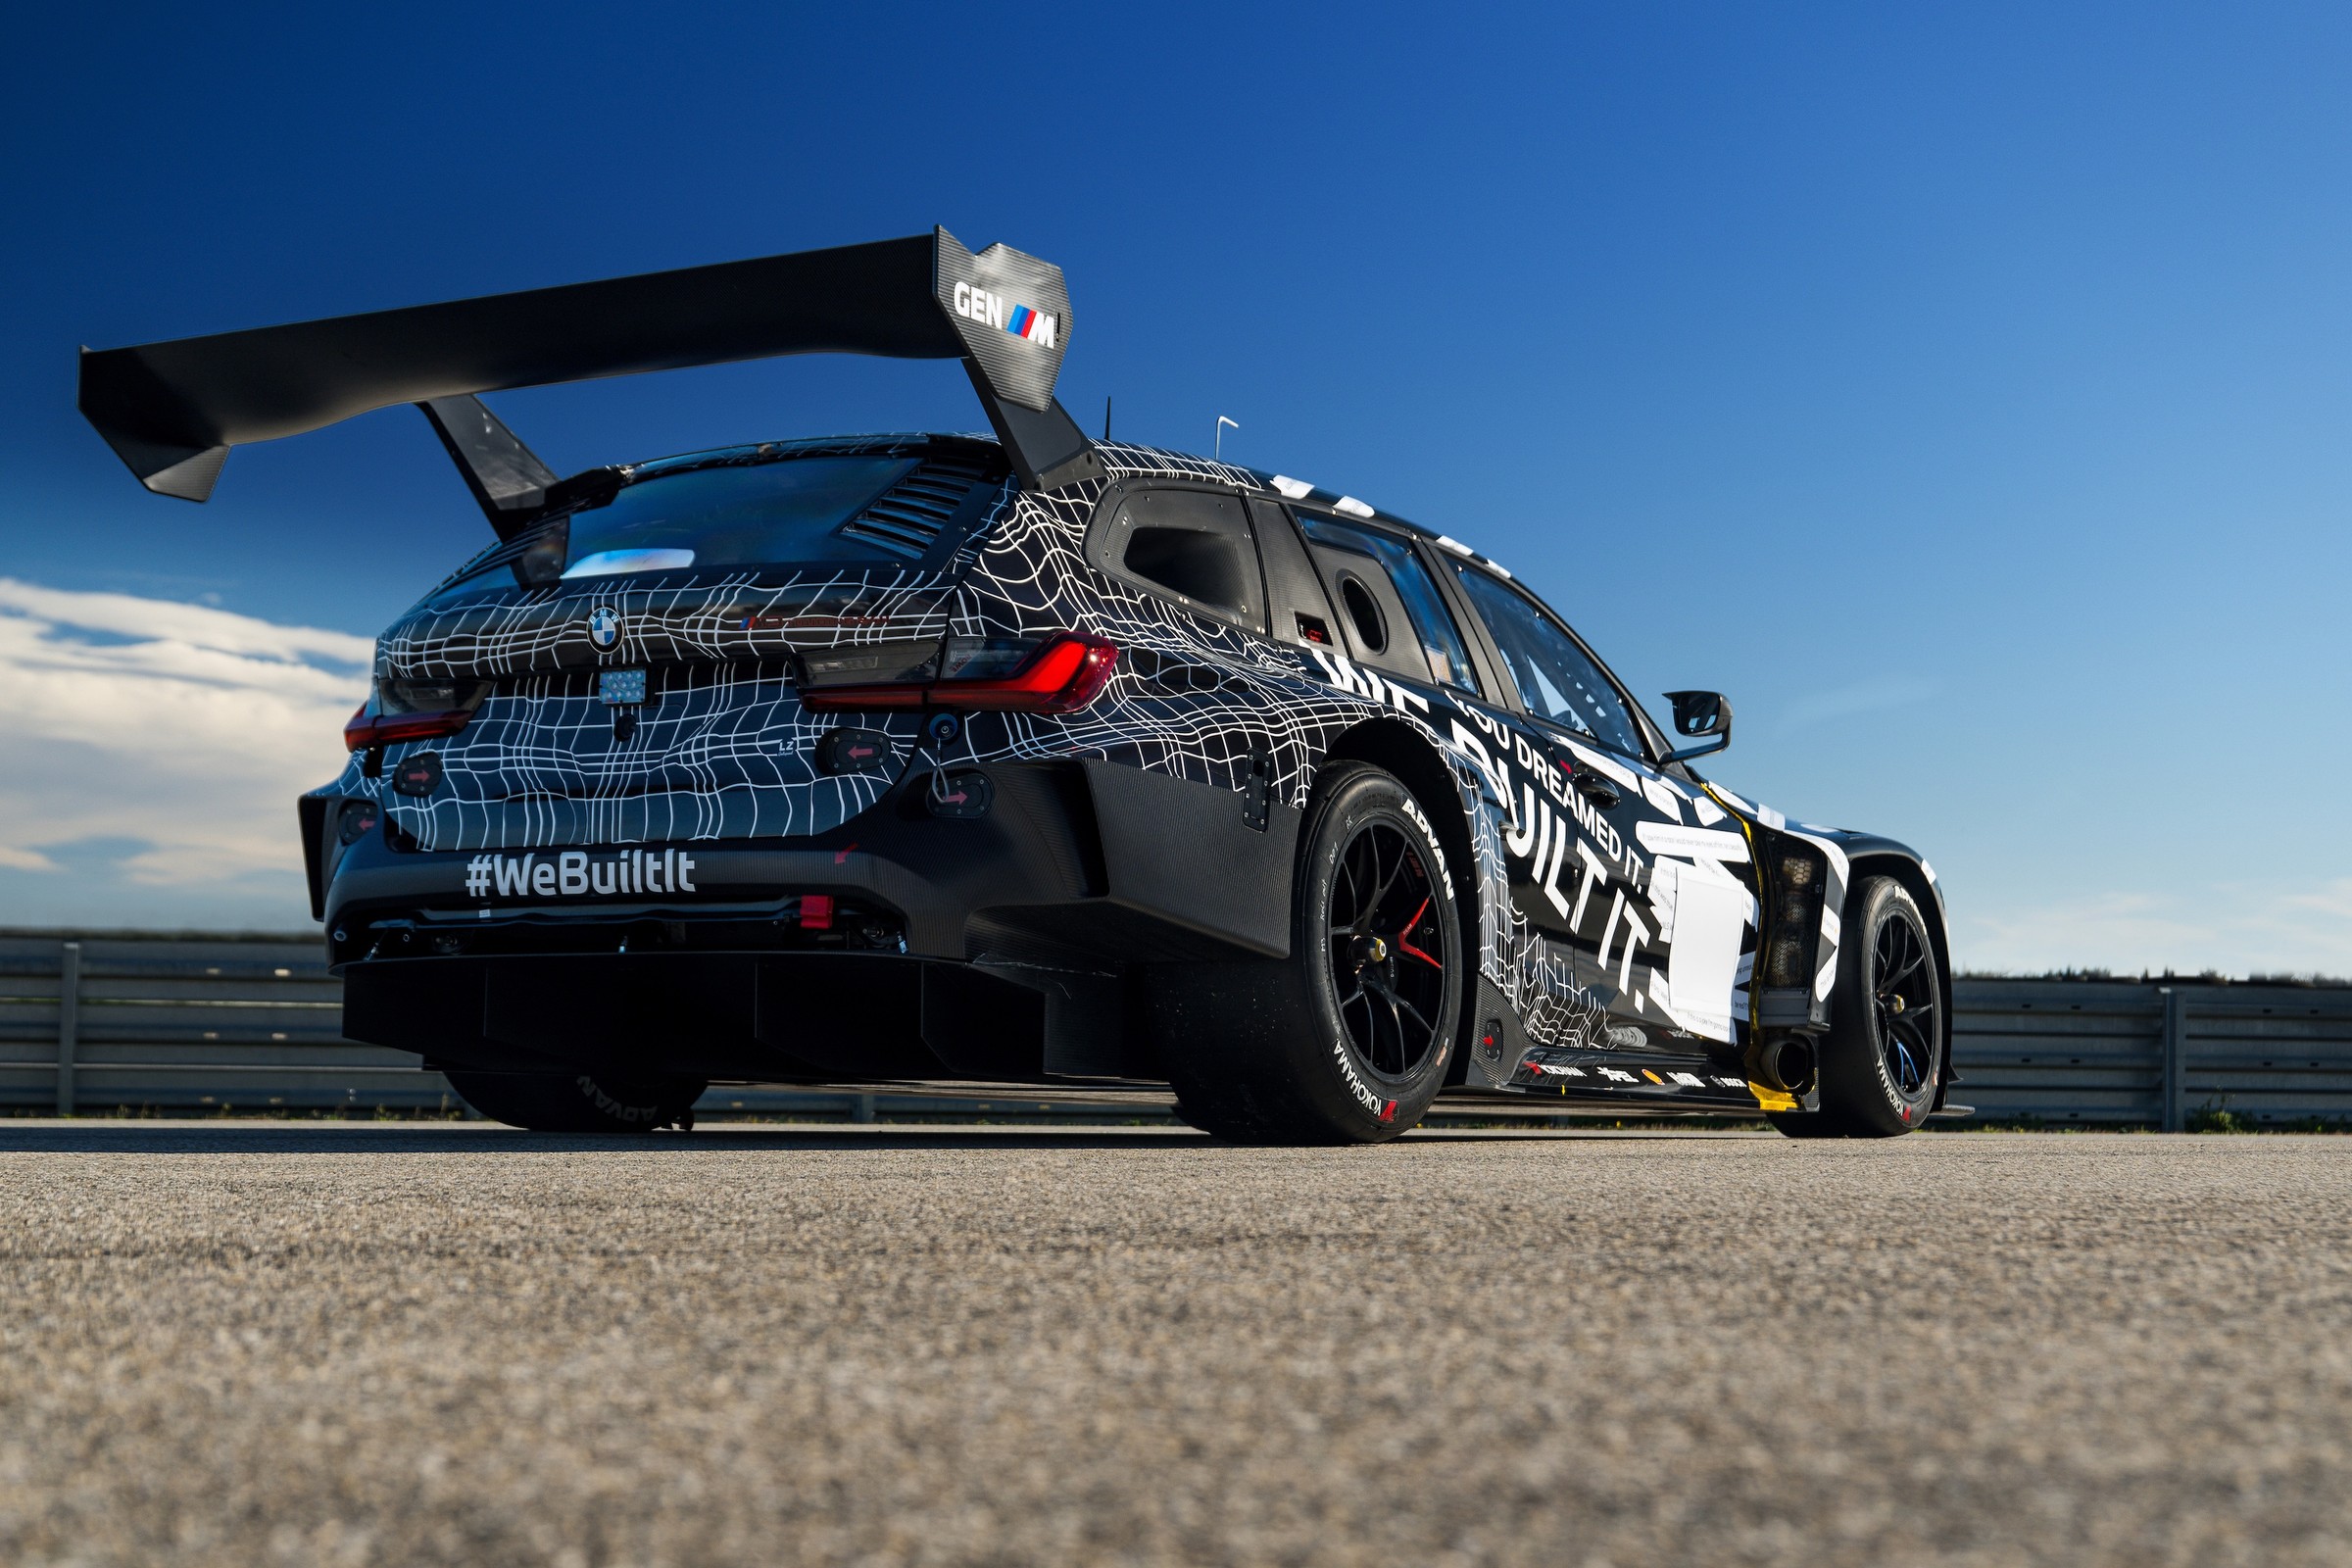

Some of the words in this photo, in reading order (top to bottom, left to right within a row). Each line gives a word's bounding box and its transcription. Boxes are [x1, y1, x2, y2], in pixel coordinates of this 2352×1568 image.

[954, 281, 1003, 329] GEN
[589, 609, 619, 625] BMW
[779, 742, 794, 752] LZ
[1445, 689, 1511, 750] YOU
[1514, 733, 1622, 862] DREAMED
[1624, 844, 1644, 895] IT.
[466, 849, 697, 897] #WeBuiltIt
[1401, 798, 1455, 901] ADVAN
[1597, 887, 1650, 1013] IT.
[576, 1076, 658, 1122] ADVAN
[1334, 1039, 1383, 1117] YOKOHAMA
[1876, 1057, 1904, 1117] YOKOHAMA
